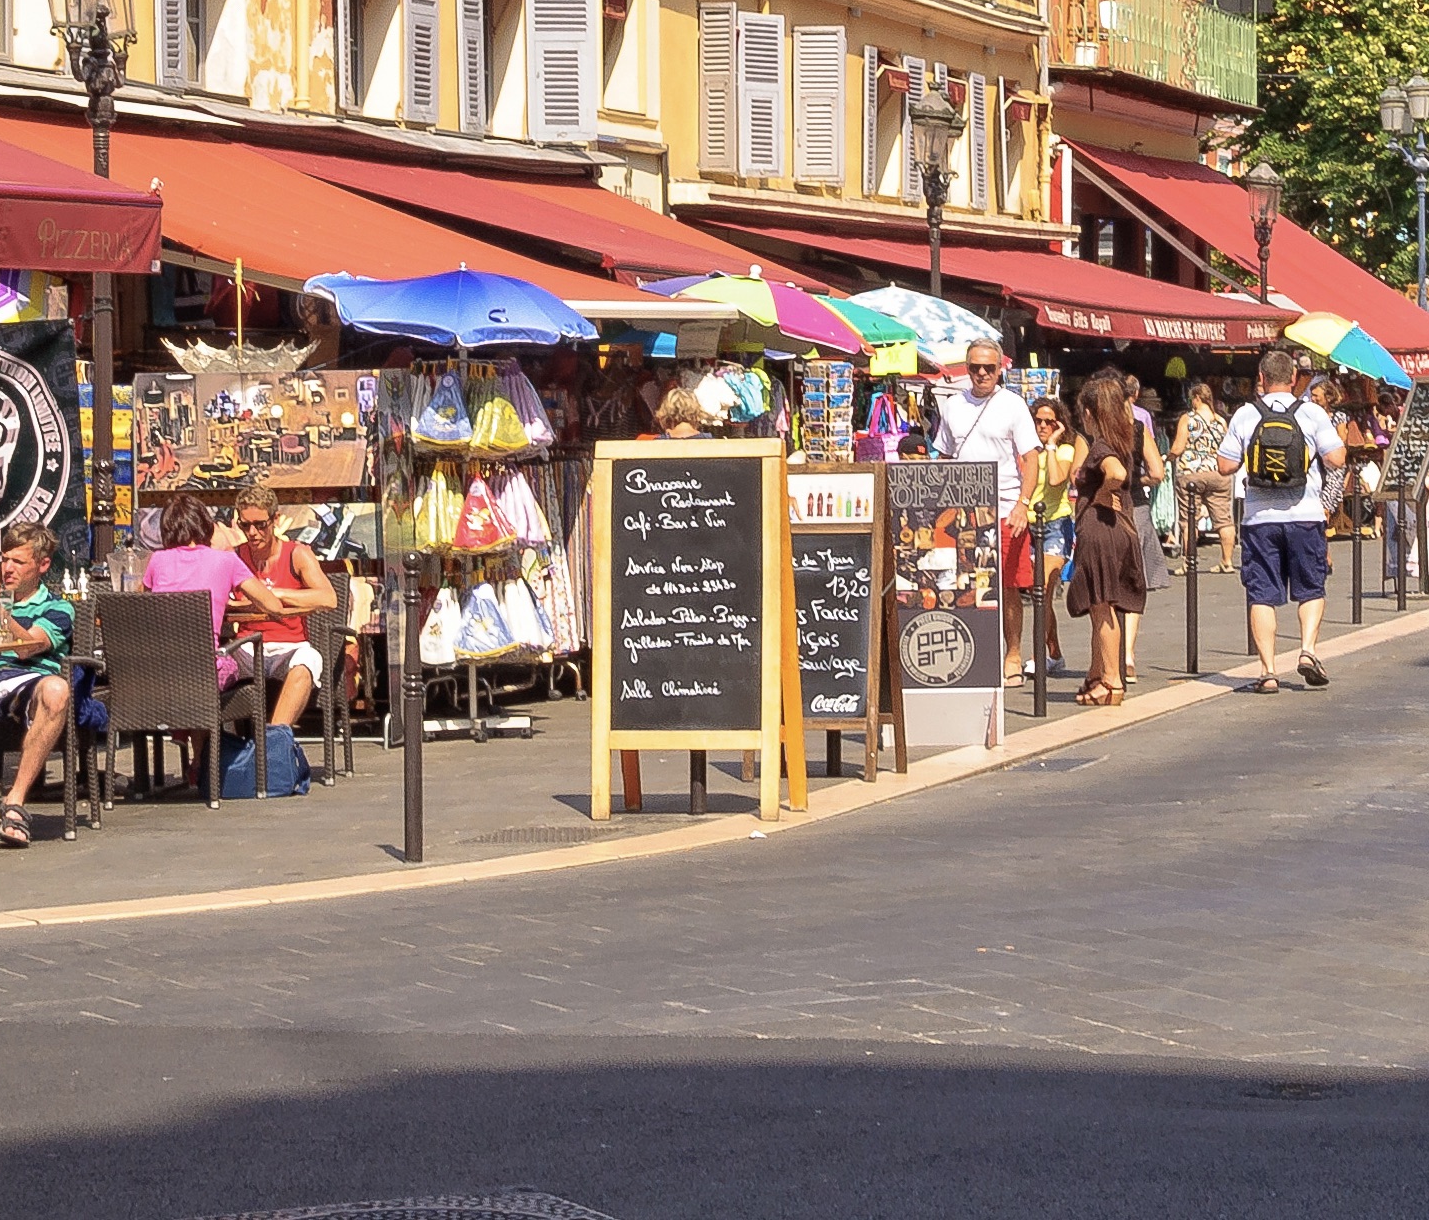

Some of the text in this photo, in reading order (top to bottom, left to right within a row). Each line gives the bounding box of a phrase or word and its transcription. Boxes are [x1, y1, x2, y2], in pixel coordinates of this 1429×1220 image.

[29, 384, 63, 453] LIMITEE
[625, 468, 702, 494] Brasserie
[888, 464, 994, 487] RT&TEE
[661, 490, 736, 509] Restaurant
[889, 484, 994, 509] OP-ART
[623, 511, 652, 541] Café
[658, 512, 688, 530] Bar
[705, 509, 727, 528] Vin
[810, 598, 860, 622] Farcis
[674, 631, 714, 647] Fruits
[717, 633, 731, 646] de
[731, 632, 752, 652] Mer
[917, 628, 958, 651] pop
[917, 647, 958, 667] art
[620, 678, 654, 702] Salle
